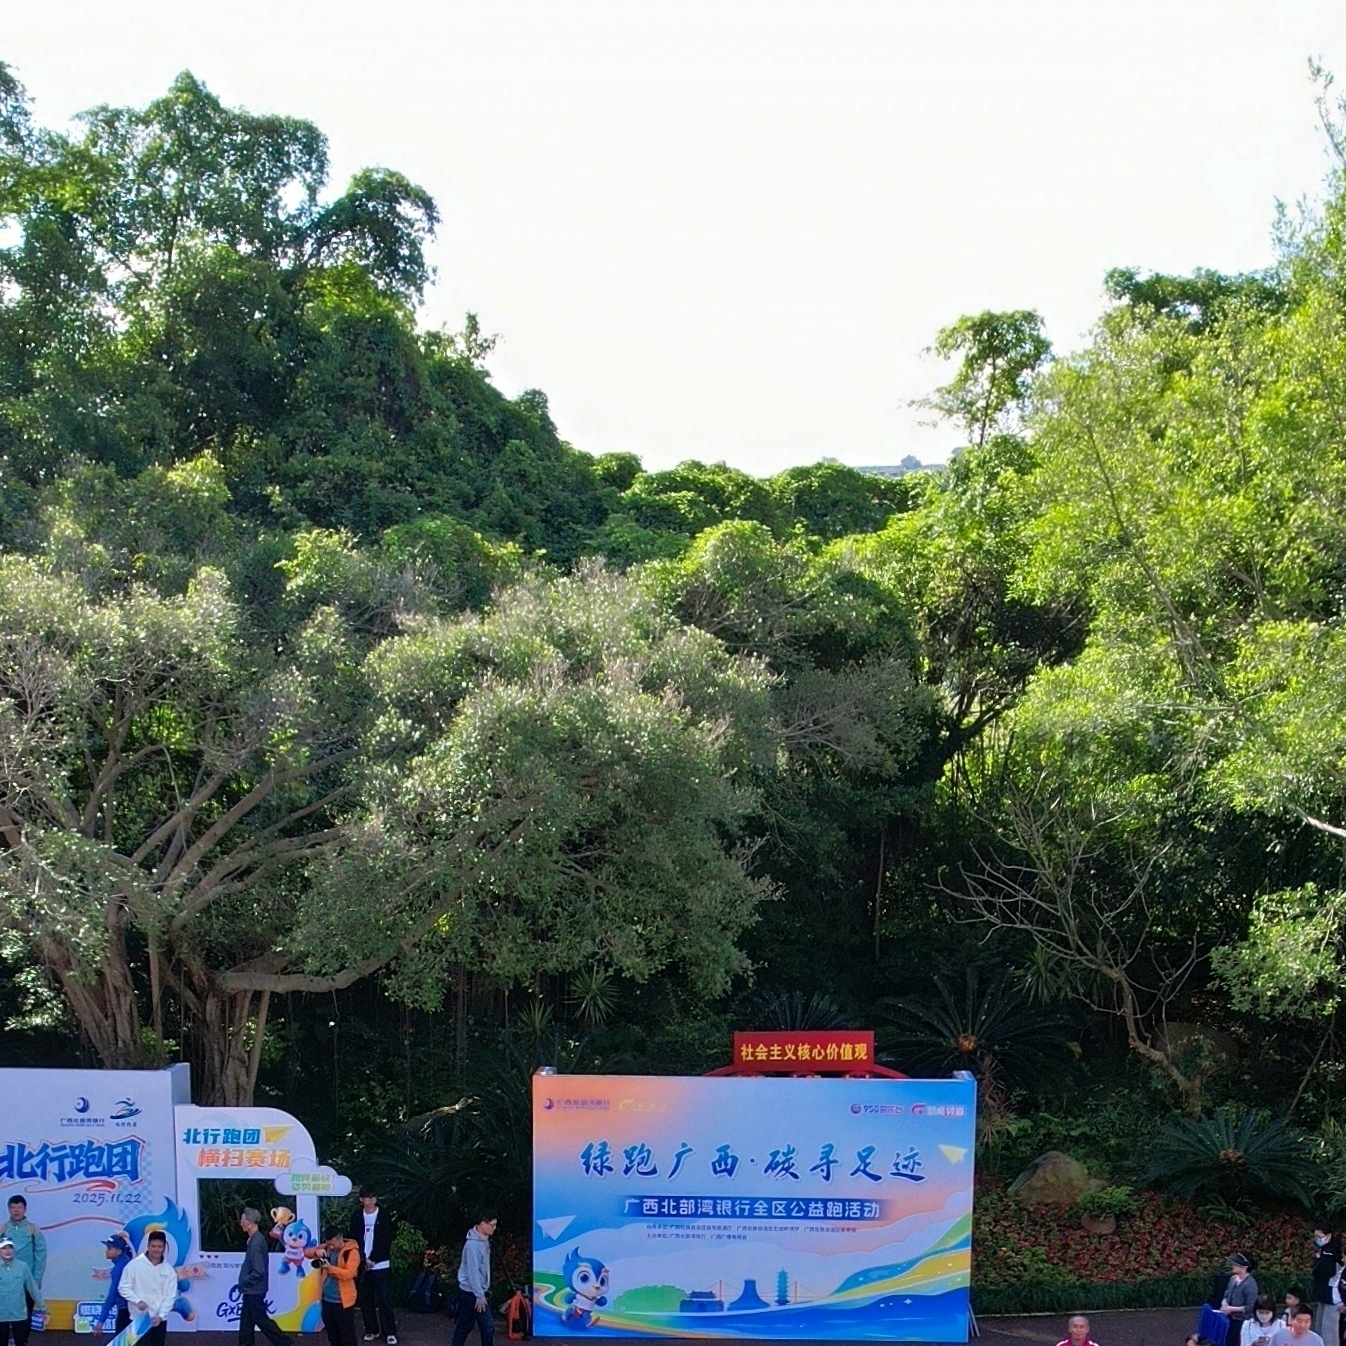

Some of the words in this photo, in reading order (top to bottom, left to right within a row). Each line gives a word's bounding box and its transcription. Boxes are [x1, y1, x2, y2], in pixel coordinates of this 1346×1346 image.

[740, 1042, 868, 1061] 社会主义核心价值观
[183, 1128, 261, 1145] 北行跑团
[197, 1149, 292, 1168] 横扫赛场
[579, 1139, 928, 1184] 绿跑广西·碳寻足迹
[73, 1193, 142, 1206] 2025.11.22
[624, 1197, 881, 1219] 广西北部湾银行全区公益跑活动
